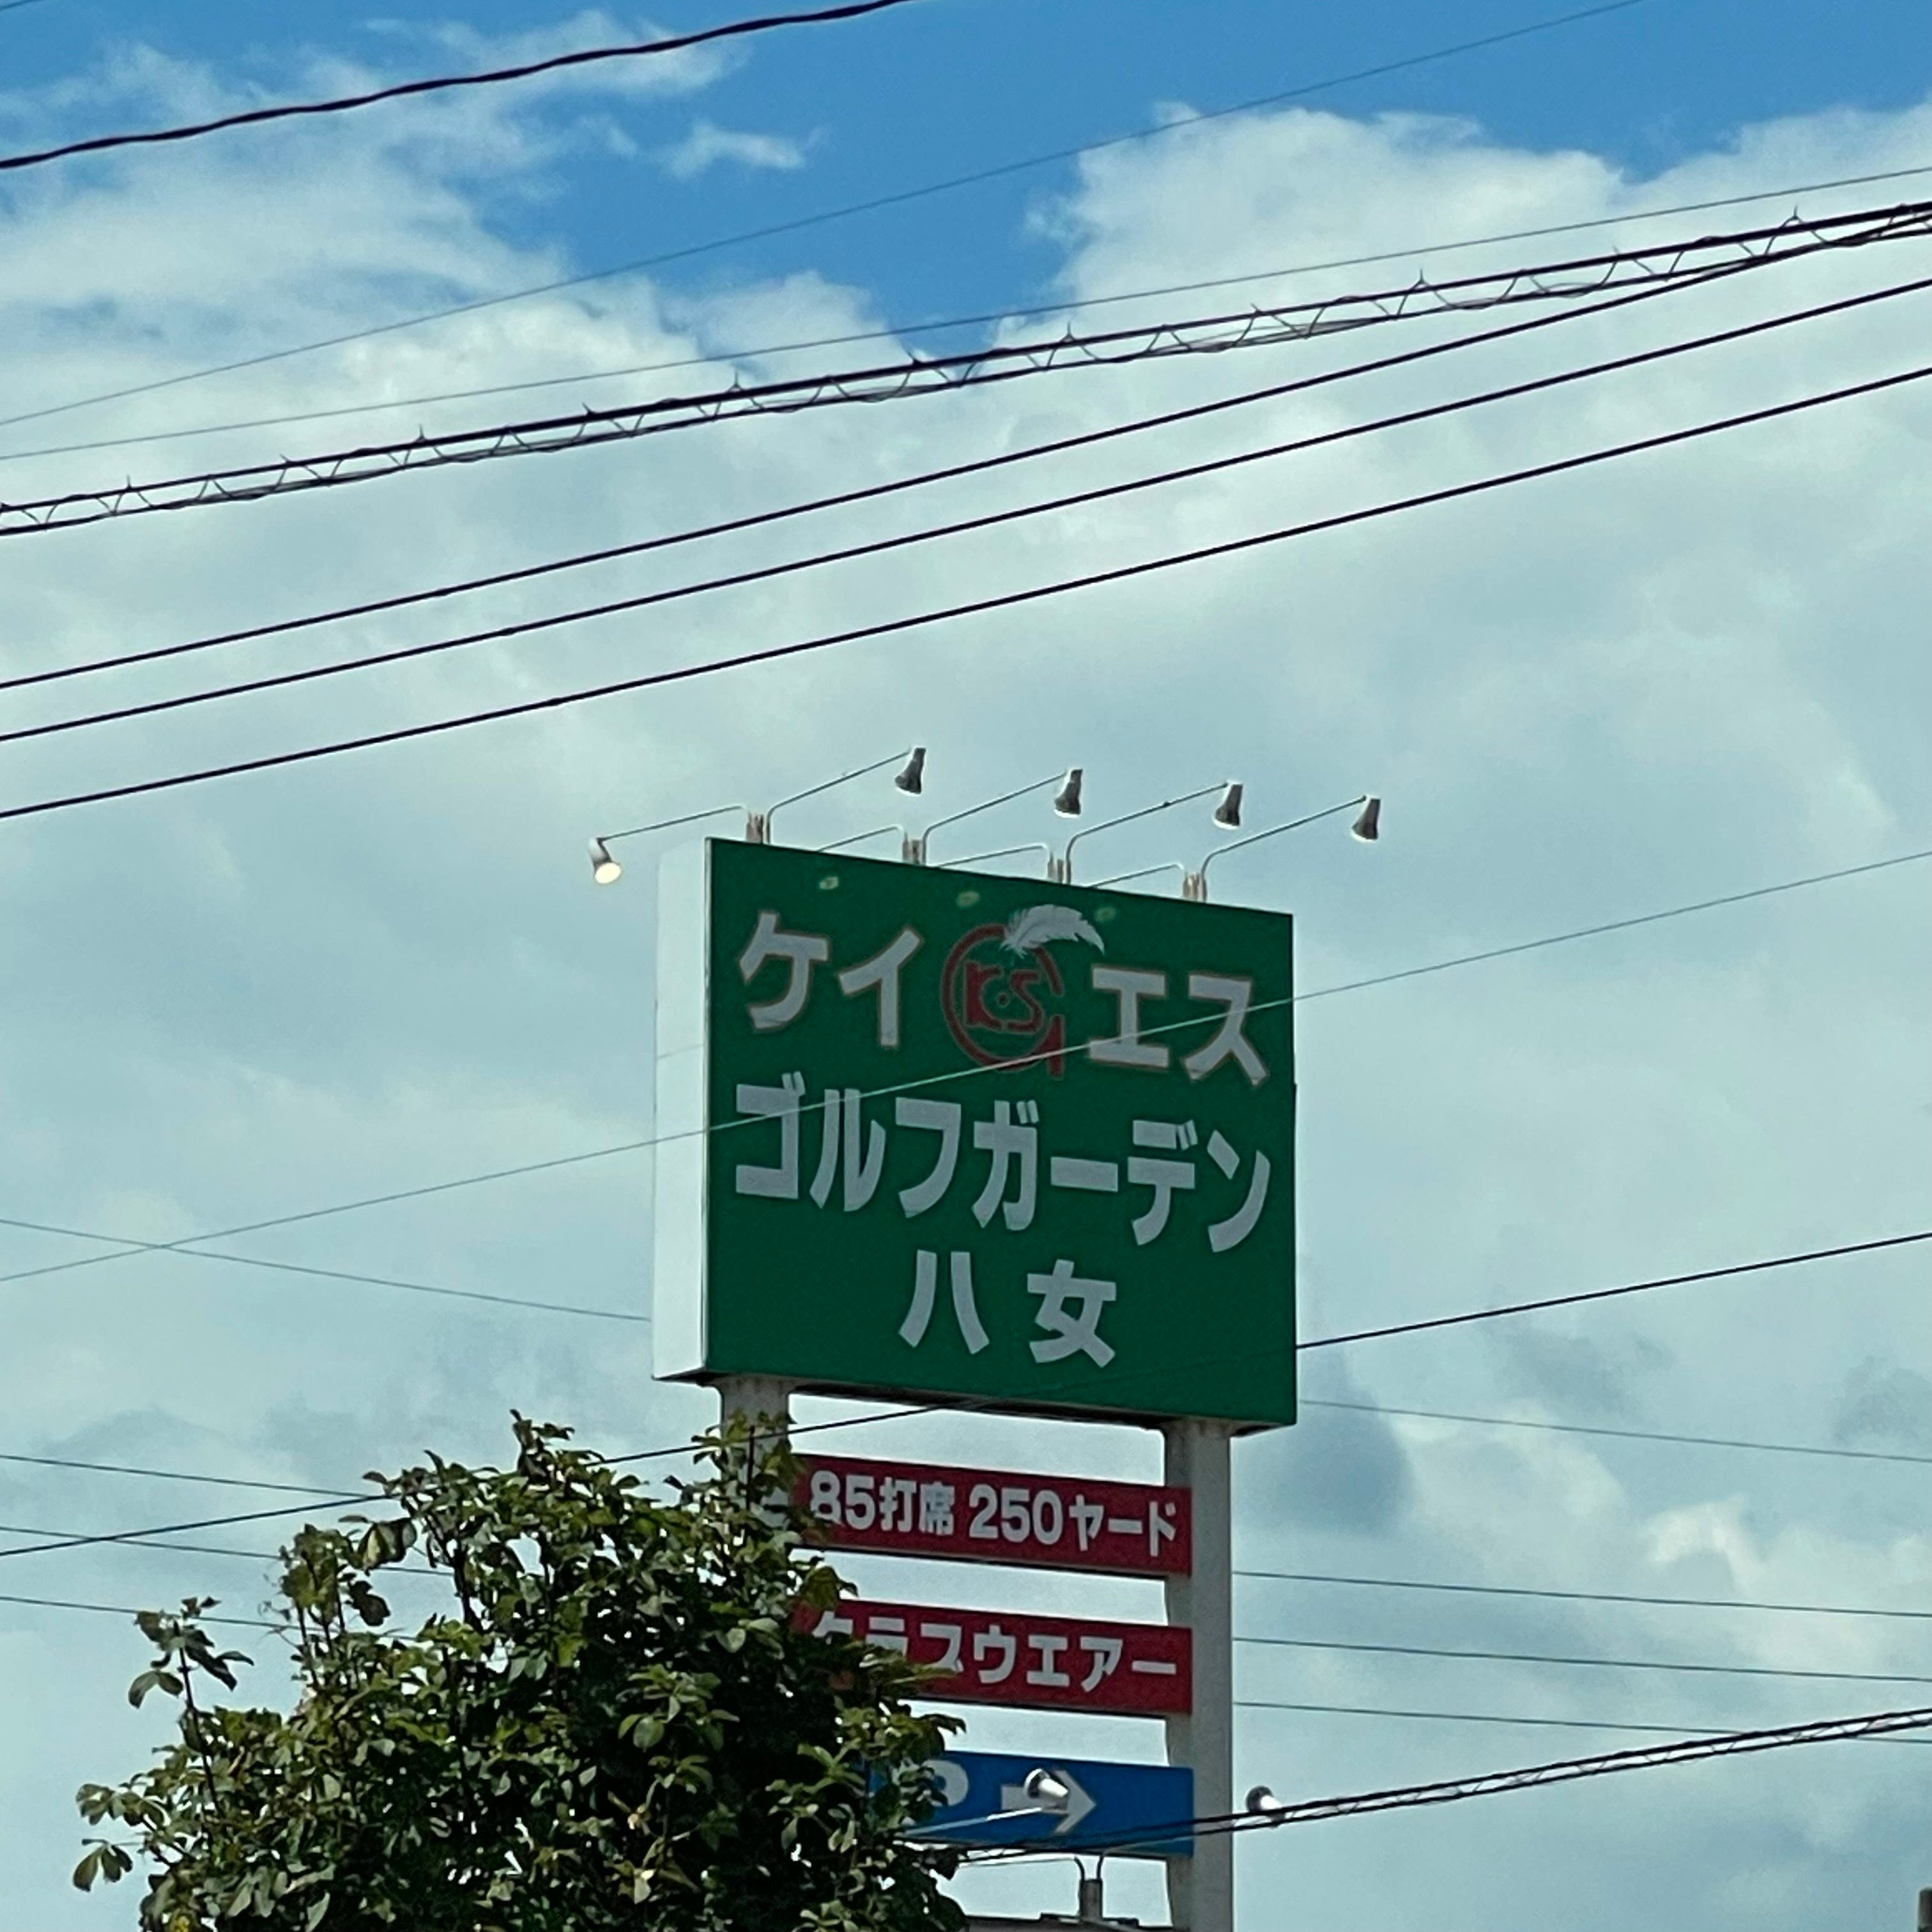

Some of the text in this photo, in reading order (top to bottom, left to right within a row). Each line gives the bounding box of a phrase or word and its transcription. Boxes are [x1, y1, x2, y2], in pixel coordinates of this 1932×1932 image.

[739, 910, 924, 1048] ケイ
[1087, 966, 1269, 1085] エス
[735, 1071, 1271, 1253] ゴルフガーデン
[898, 1249, 1117, 1369] 八女
[809, 1469, 1177, 1557] 85打席 250ヤード
